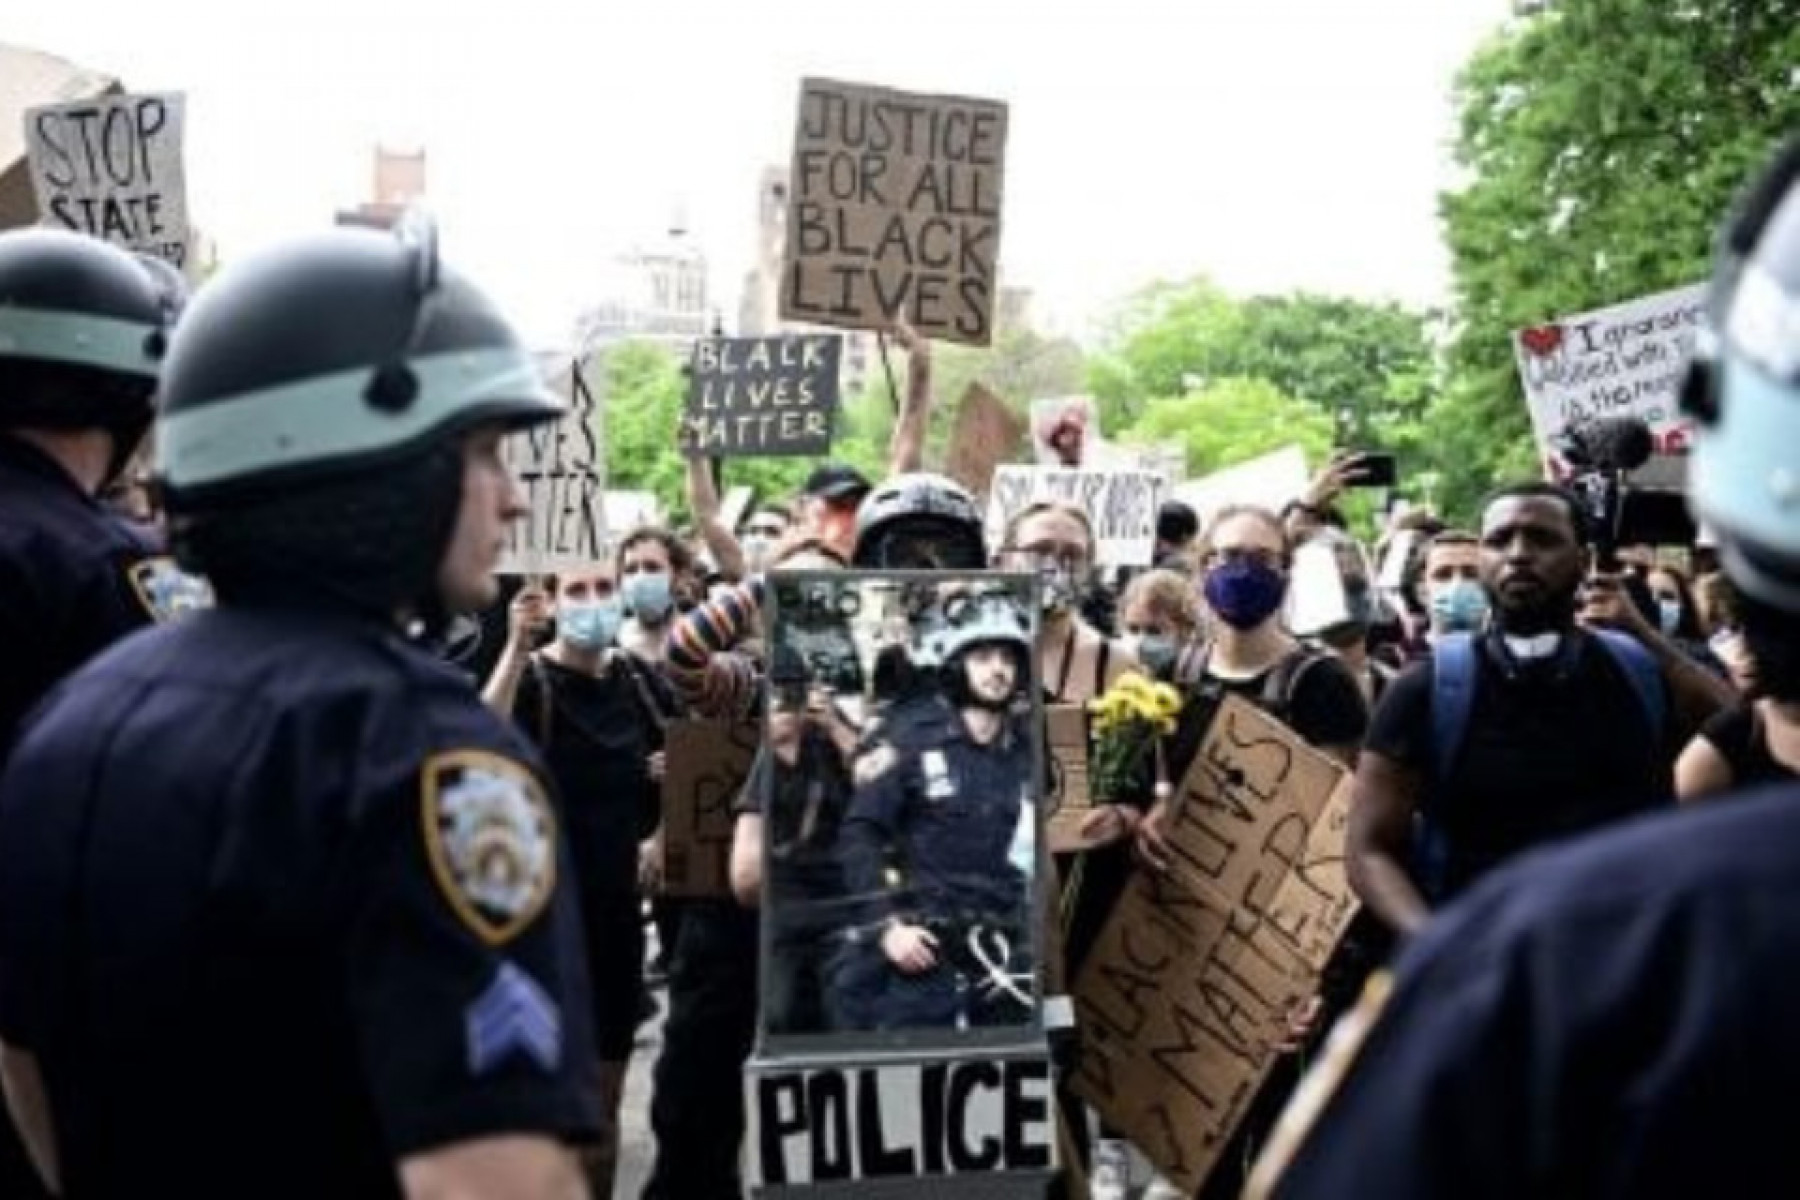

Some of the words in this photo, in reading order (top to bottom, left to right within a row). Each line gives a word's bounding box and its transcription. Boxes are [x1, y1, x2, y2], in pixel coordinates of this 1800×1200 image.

[37, 98, 166, 187] STOP
[803, 89, 997, 165] JUSTICE
[50, 193, 164, 240] STATE
[799, 150, 887, 204] FOR
[907, 162, 999, 217] ALL
[798, 201, 994, 278] BLACK
[790, 259, 988, 336] LIVES
[688, 410, 826, 449] MATTER
[702, 377, 814, 410] LIVES
[1162, 711, 1293, 880] LIVES
[1151, 811, 1346, 1110] MATTER
[758, 1059, 1052, 1184] POLICE
